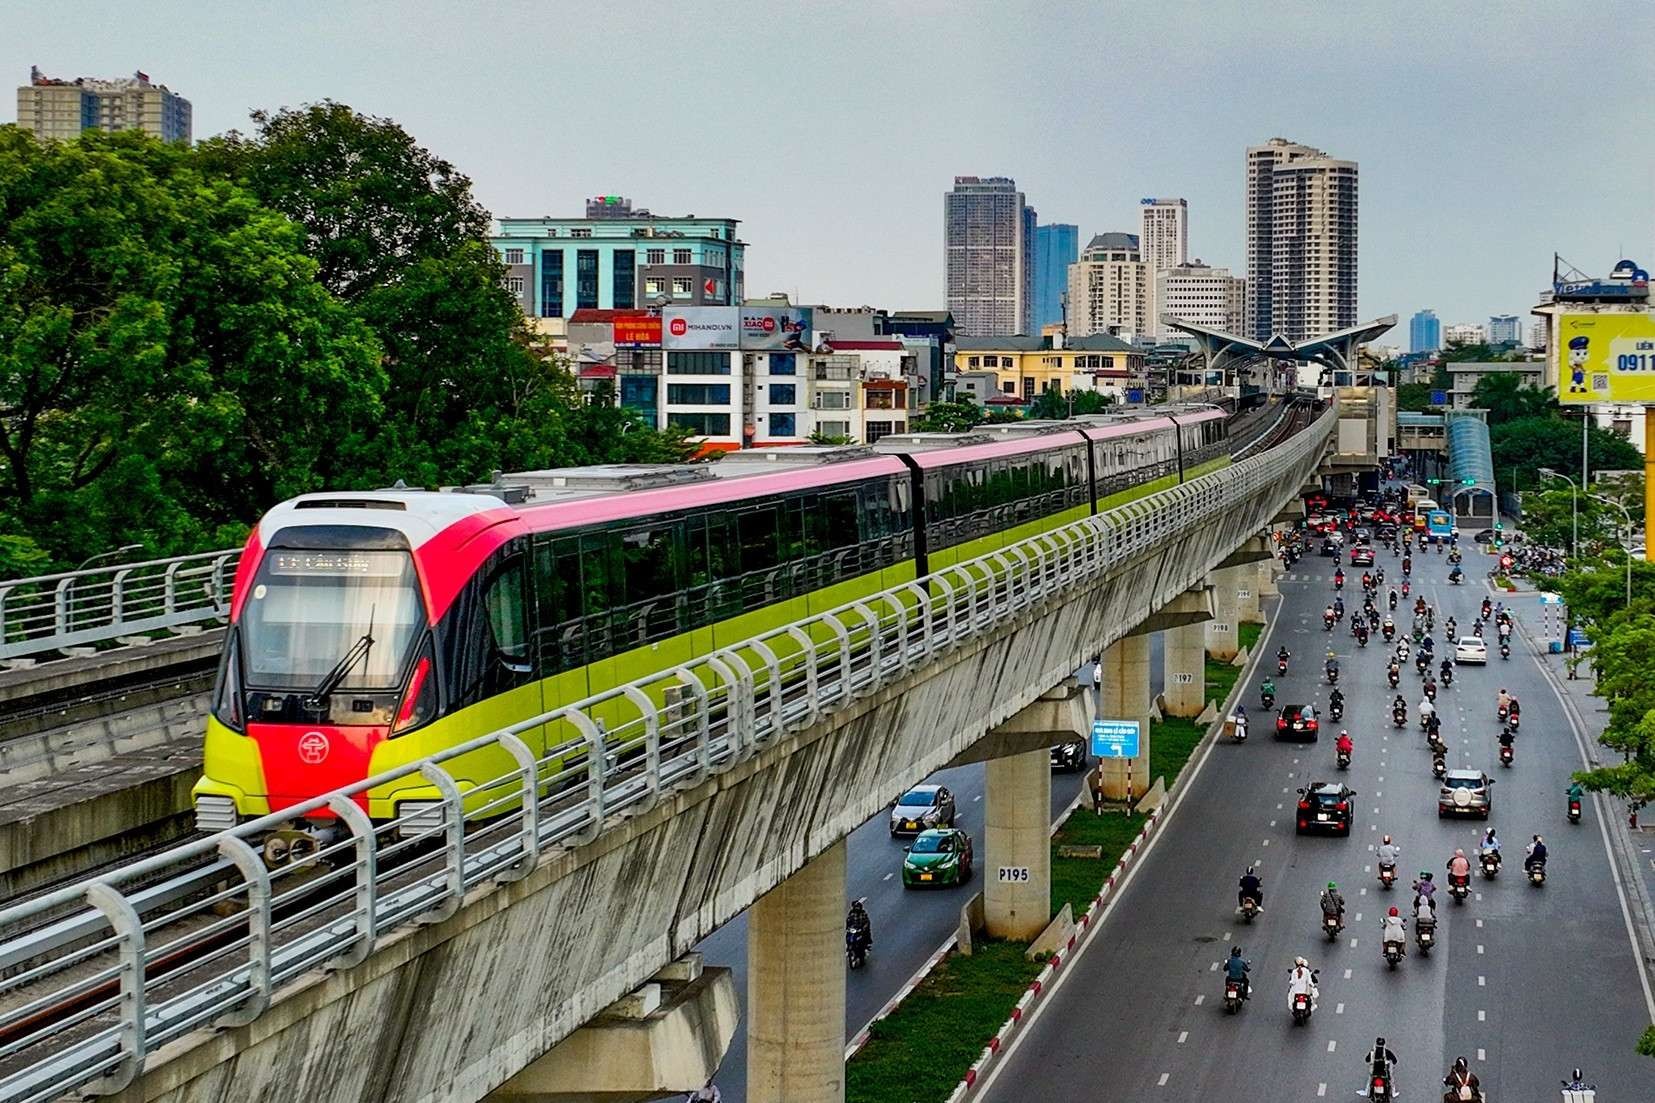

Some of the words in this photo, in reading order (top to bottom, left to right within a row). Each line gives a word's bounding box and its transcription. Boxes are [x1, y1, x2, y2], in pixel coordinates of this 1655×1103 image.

[1636, 341, 1654, 350] LIÊN
[1618, 354, 1655, 371] 0911
[1000, 868, 1028, 881] P195
